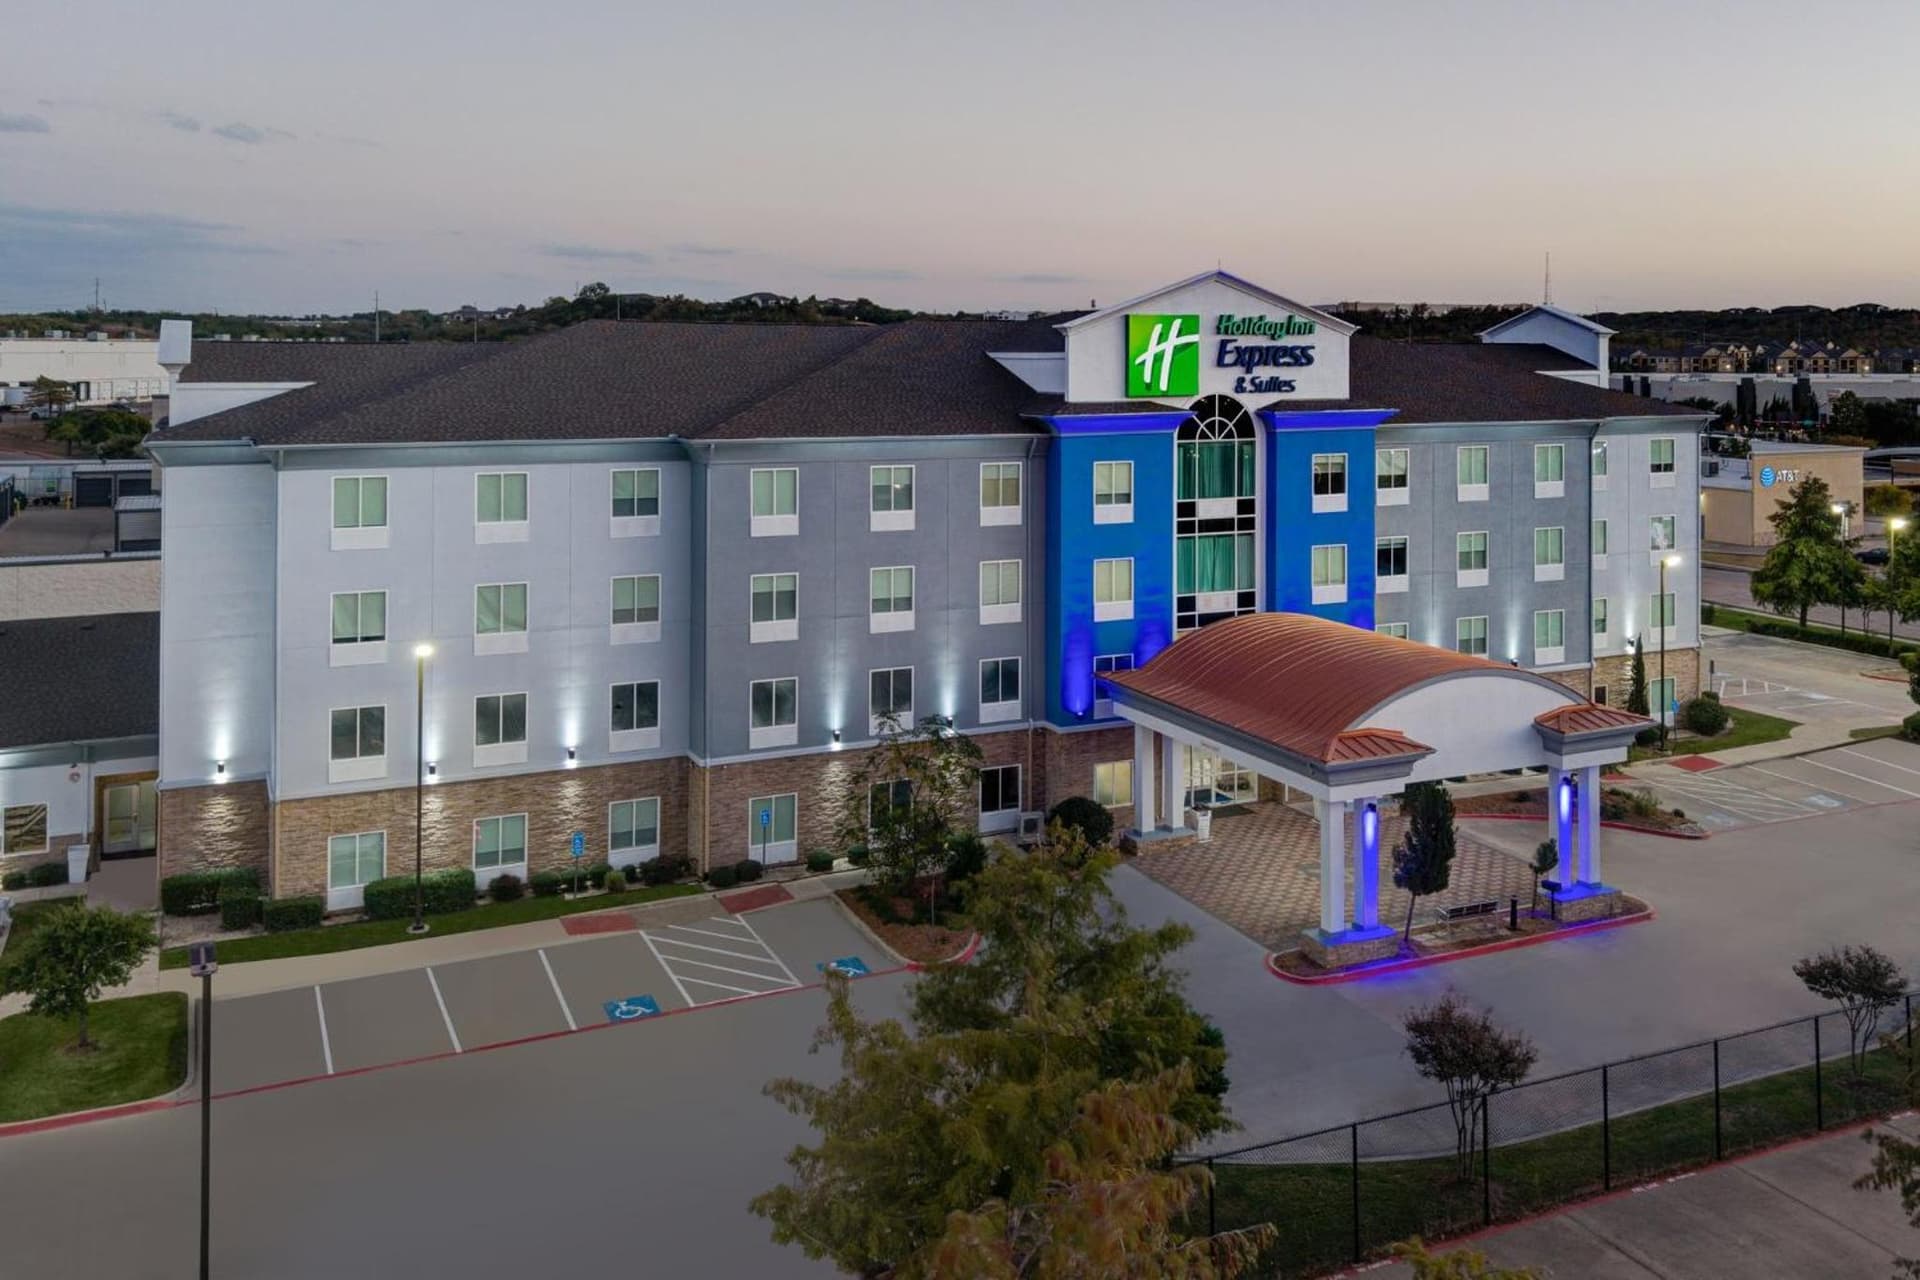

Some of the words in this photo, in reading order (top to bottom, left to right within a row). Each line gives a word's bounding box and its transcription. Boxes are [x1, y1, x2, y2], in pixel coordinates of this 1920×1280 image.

[1217, 339, 1316, 374] Express
[1234, 376, 1247, 394] &
[1248, 376, 1297, 394] Suites
[1776, 470, 1800, 482] AT&T
